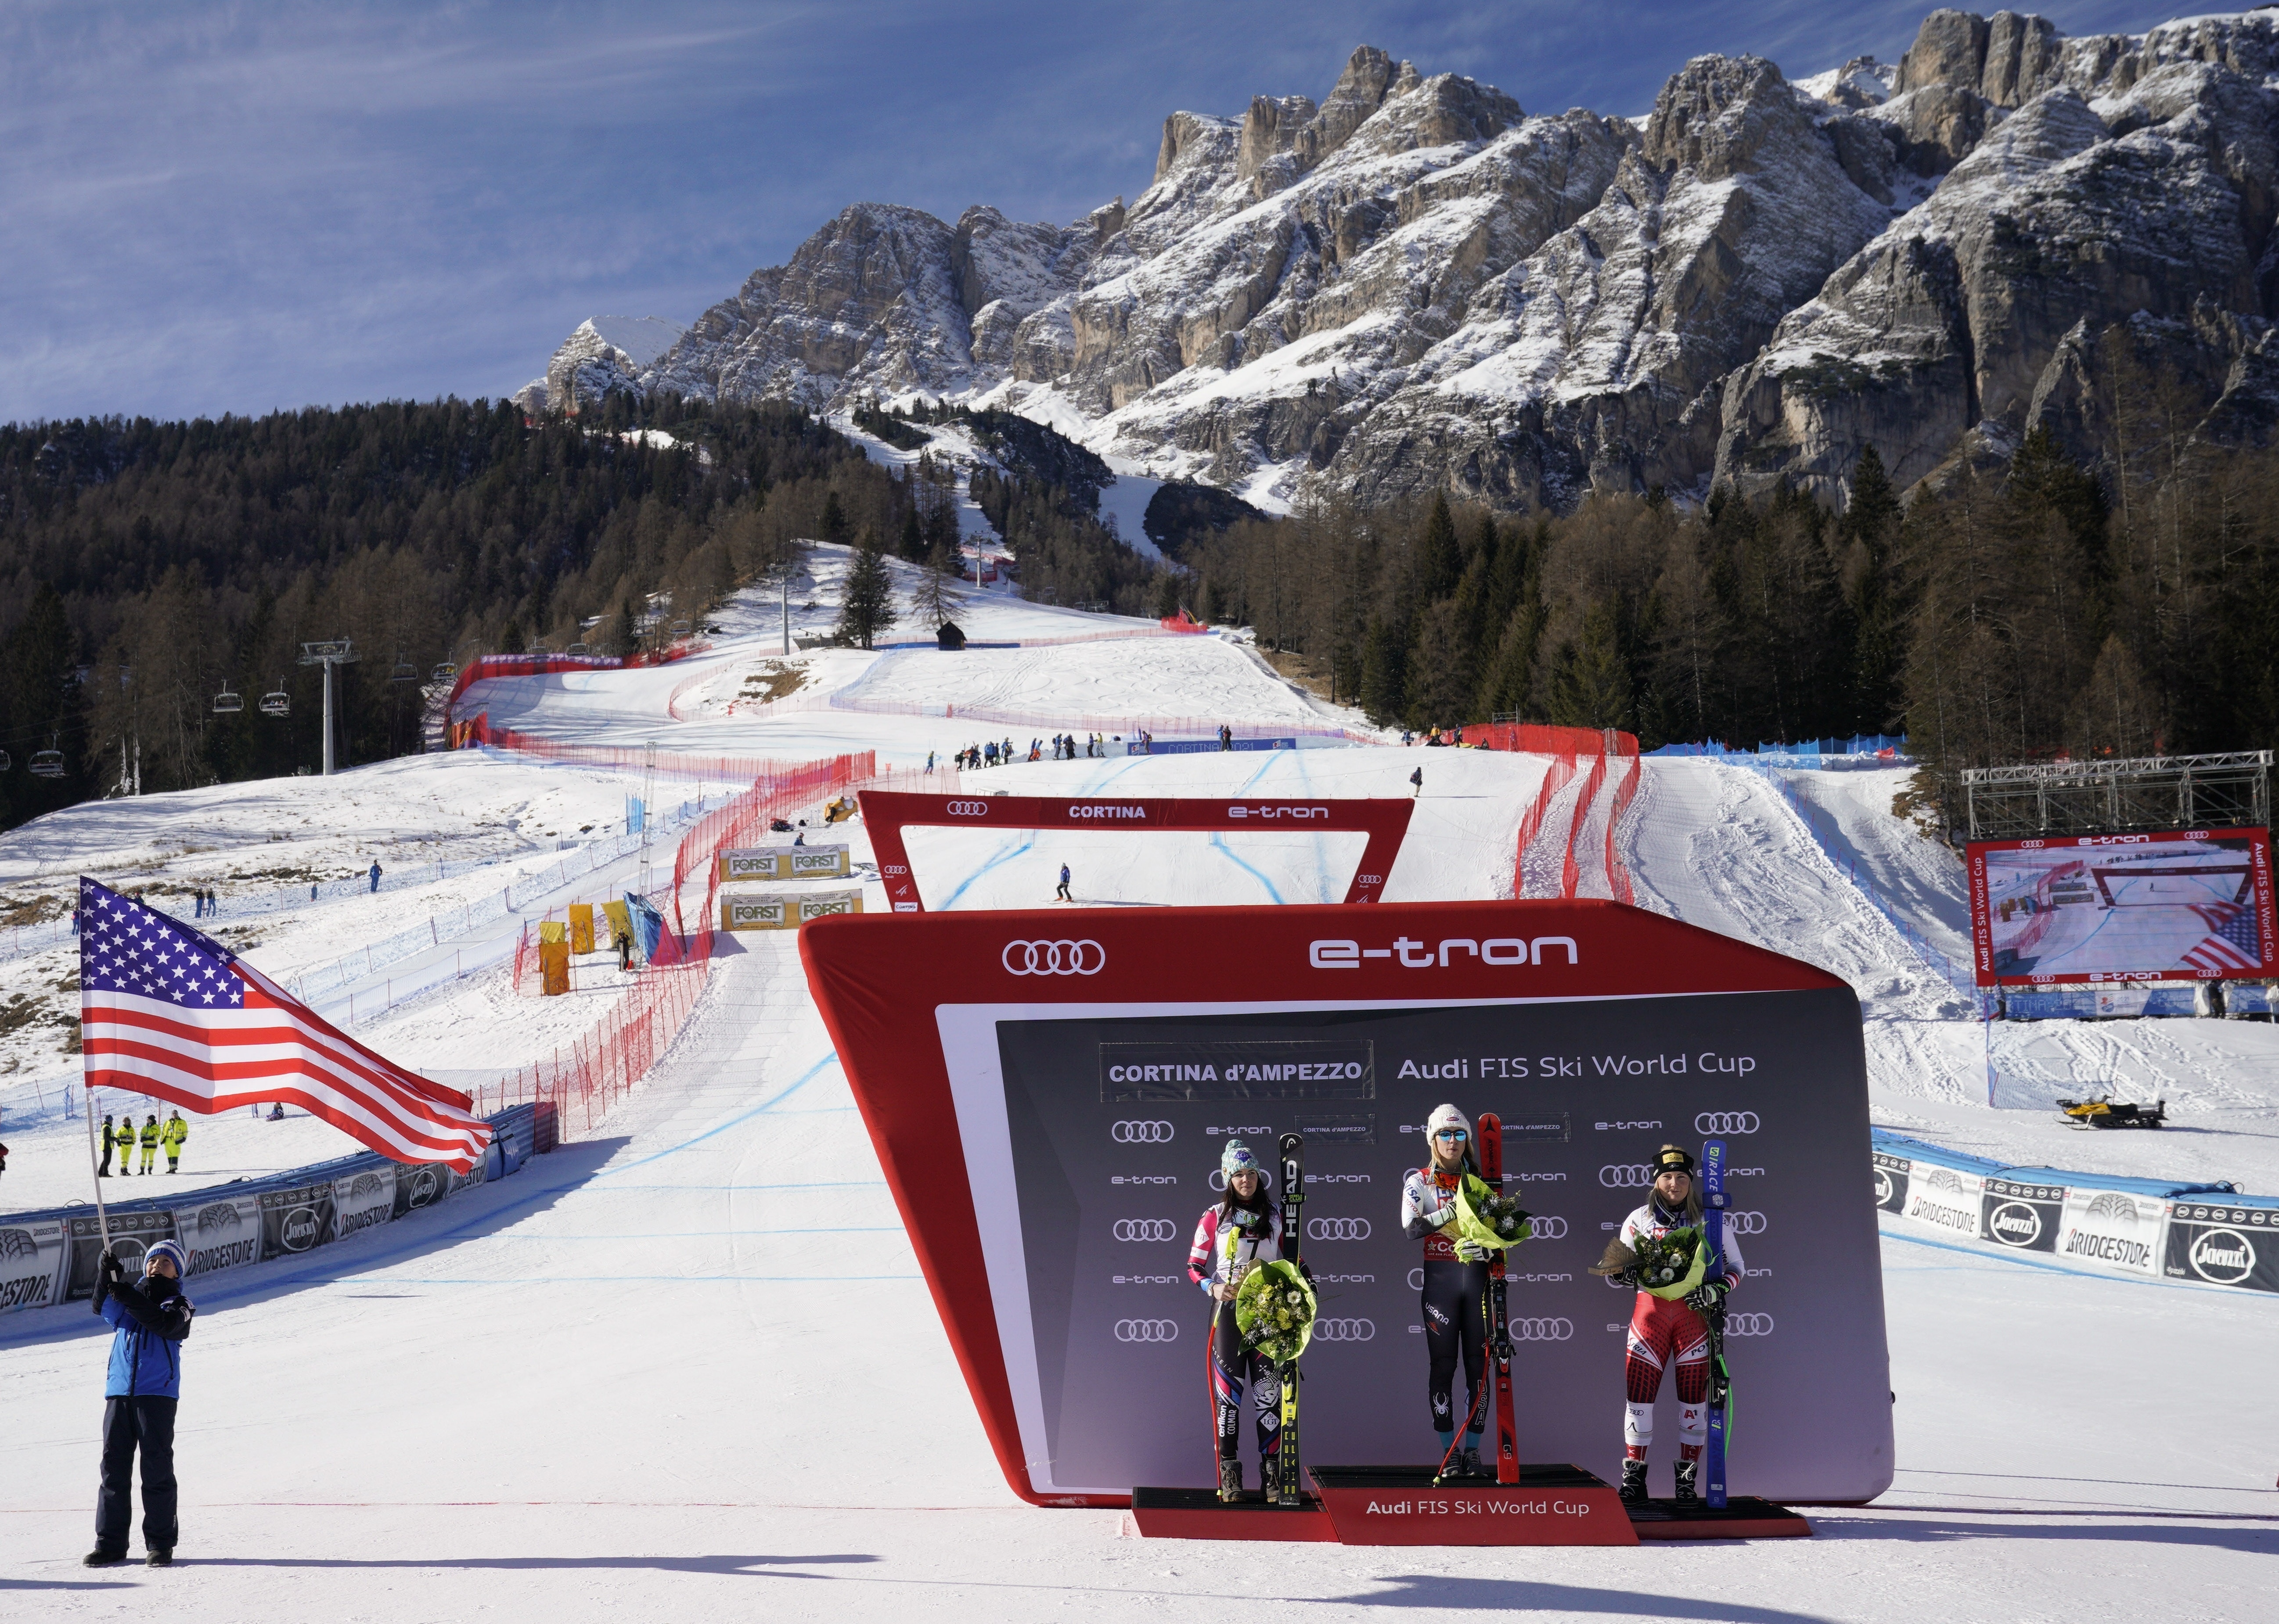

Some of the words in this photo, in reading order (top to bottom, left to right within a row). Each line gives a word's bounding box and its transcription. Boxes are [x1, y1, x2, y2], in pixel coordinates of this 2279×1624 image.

[1168, 743, 1220, 755] CORTINA
[1069, 805, 1146, 819] CORTINA
[1228, 806, 1329, 819] e-tron
[2078, 835, 2150, 846] e-tron
[795, 854, 837, 869] FORST
[2254, 843, 2266, 868] Audi
[732, 858, 775, 871] FORST
[1973, 857, 1983, 877] Cup
[2257, 870, 2268, 887] FIS
[1975, 879, 1985, 910] World
[2259, 889, 2269, 905] Ski
[735, 905, 781, 920] FORST
[803, 902, 849, 917] FORST
[1977, 912, 1986, 926] Ski
[2261, 906, 2273, 939] World
[1978, 928, 1987, 945] FIS
[1309, 936, 1578, 969] e-tron
[1980, 947, 1990, 972] Audi
[2264, 941, 2274, 962] Cup
[2089, 971, 2162, 982] e-tron
[1109, 1064, 1218, 1082] CORTINA
[1224, 1062, 1362, 1081] d'AMPEZZO
[1397, 1059, 1468, 1079] Audi
[1480, 1058, 1529, 1078] FIS
[1540, 1057, 1581, 1077] Ski
[1591, 1053, 1687, 1076] World
[1698, 1053, 1756, 1078] Cup
[1206, 1126, 1271, 1135] e-tron
[1595, 1121, 1662, 1130] e-tron
[1111, 1175, 1177, 1184] e-tron
[1304, 1174, 1371, 1183] e-tron
[1501, 1173, 1566, 1182] e-tron
[1285, 1160, 1297, 1237] HEAD
[1404, 1180, 1421, 1204] VISA
[1911, 1196, 1975, 1233] BRIDGESTONE
[286, 1216, 316, 1241] Jacuzzi
[1995, 1212, 2034, 1235] Jacuzzi
[1247, 1239, 1259, 1262] 7
[2065, 1228, 2151, 1268] BRIDGESTONE
[2197, 1243, 2246, 1268] Jacuzzi
[184, 1238, 255, 1278] BRIDGESTONE
[1112, 1275, 1179, 1284] e-tron
[1505, 1273, 1572, 1282] e-tron
[1425, 1301, 1449, 1325] USANA
[1227, 1409, 1237, 1435] COLMAR
[1683, 1409, 1698, 1419] A1
[1503, 1444, 1512, 1460] G9
[1366, 1501, 1411, 1514] Audi
[1418, 1501, 1448, 1514] FIS
[1455, 1501, 1481, 1514] Ski
[1487, 1501, 1546, 1514] World
[1553, 1501, 1589, 1517] Cup
